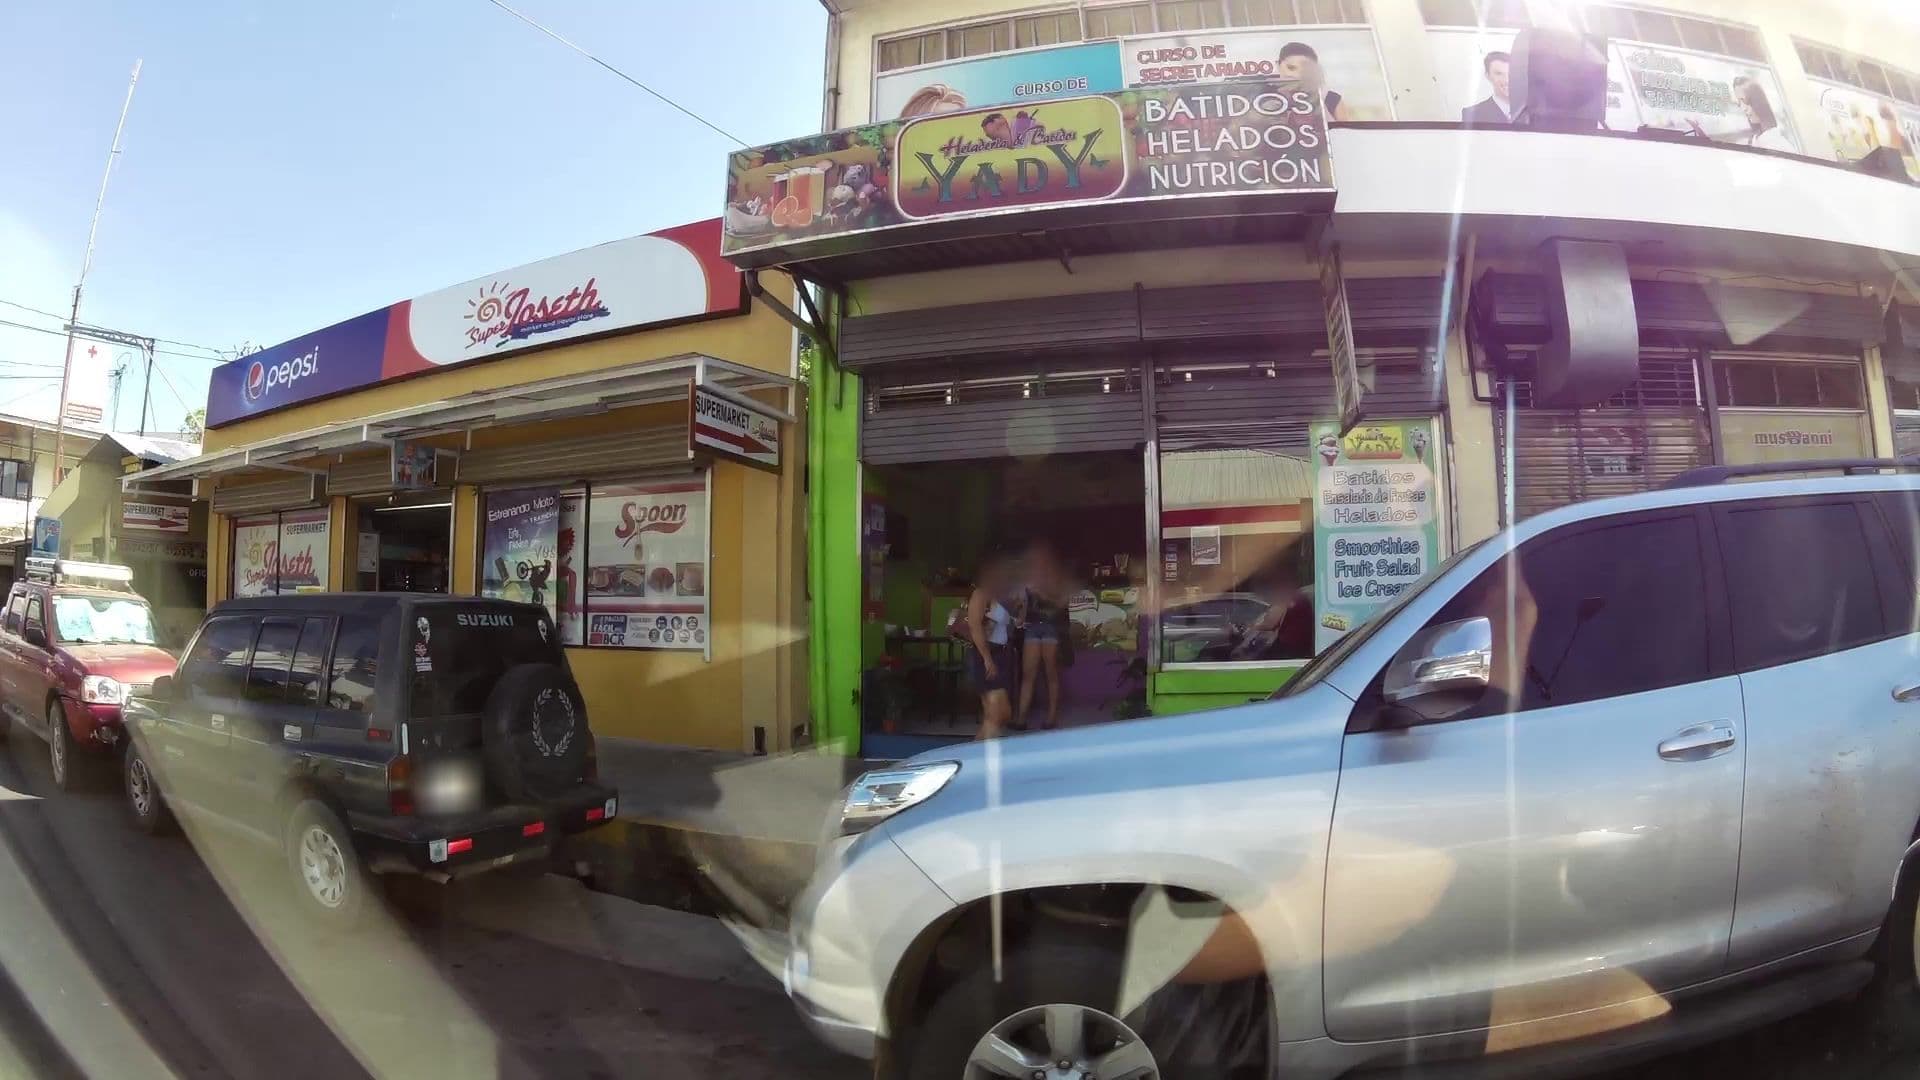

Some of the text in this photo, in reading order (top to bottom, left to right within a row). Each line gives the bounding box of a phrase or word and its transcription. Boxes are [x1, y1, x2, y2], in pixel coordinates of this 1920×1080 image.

[1137, 44, 1226, 64] CURSO DE
[1139, 61, 1274, 82] SECRETARIADO
[1014, 77, 1087, 96] CURSO DE
[1145, 92, 1313, 122] BATIDOS
[1147, 125, 1319, 156] HELADOS
[914, 128, 1104, 202] YADY
[1150, 153, 1321, 190] NUTRICIÓN
[465, 322, 508, 348] Super
[265, 345, 319, 396] pepsi
[695, 395, 750, 430] SUPERMARKET
[1334, 469, 1416, 486] Batidos
[124, 504, 165, 517] SUPERMARKET
[533, 496, 555, 510] Moto
[615, 502, 687, 539] Spoon
[1334, 507, 1418, 523] Helados
[286, 523, 326, 535] SUPERMARKET
[1334, 537, 1420, 557] Smoothies
[1334, 557, 1421, 578] Fruit Salad
[1338, 581, 1363, 598] Ice
[457, 614, 514, 627] SUZUKI
